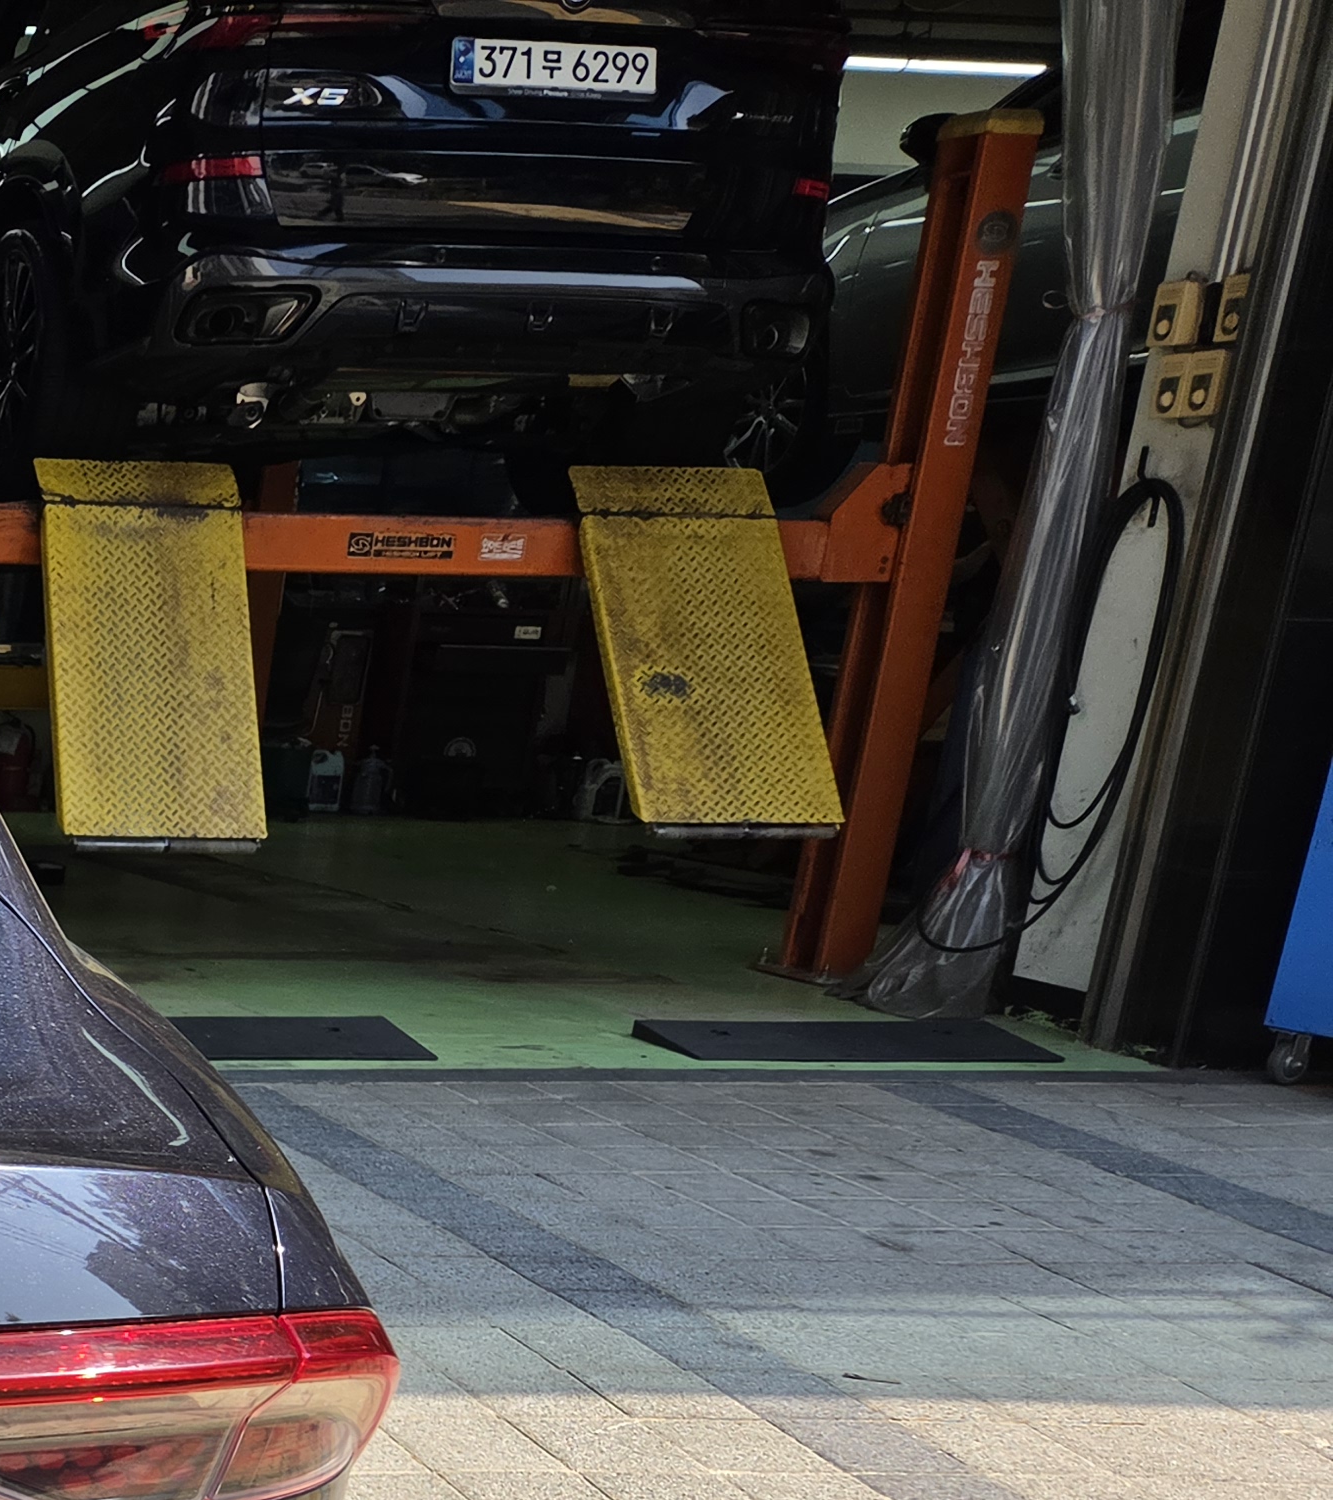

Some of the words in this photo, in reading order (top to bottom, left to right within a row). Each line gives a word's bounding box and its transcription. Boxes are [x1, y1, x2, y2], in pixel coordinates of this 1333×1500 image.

[477, 45, 563, 80] 371무
[571, 49, 650, 85] 6299
[283, 86, 350, 106] X5
[943, 259, 1001, 447] HESHBON
[374, 535, 452, 549] HESHBON
